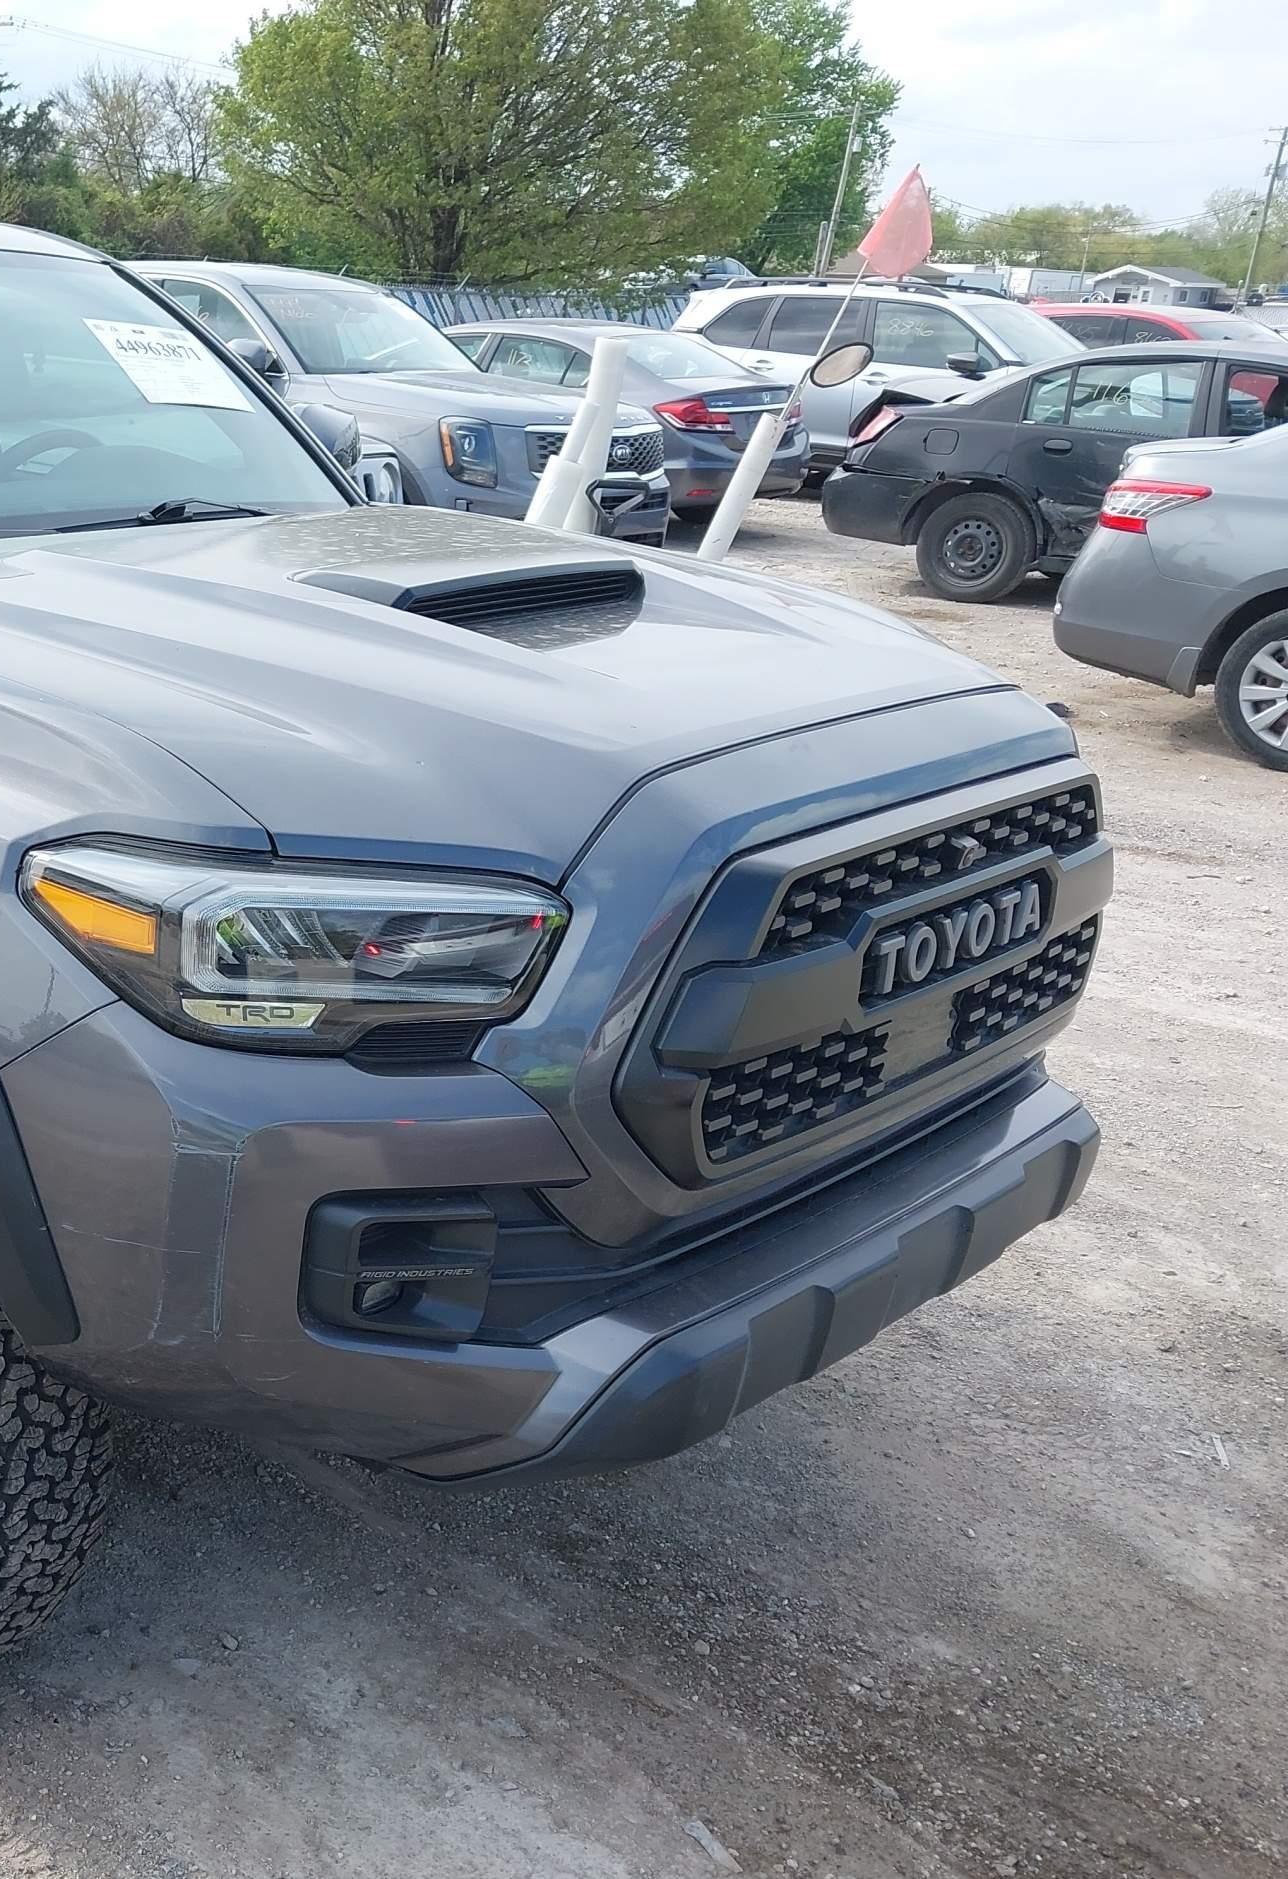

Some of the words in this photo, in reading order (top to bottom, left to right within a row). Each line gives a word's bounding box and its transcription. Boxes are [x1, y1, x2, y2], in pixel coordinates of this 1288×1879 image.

[114, 338, 202, 361] 44963871
[872, 879, 1041, 995] TOYOTA
[215, 1003, 295, 1023] TRD
[360, 1271, 396, 1279] RIGID
[396, 1268, 475, 1278] INDUSTRIES
